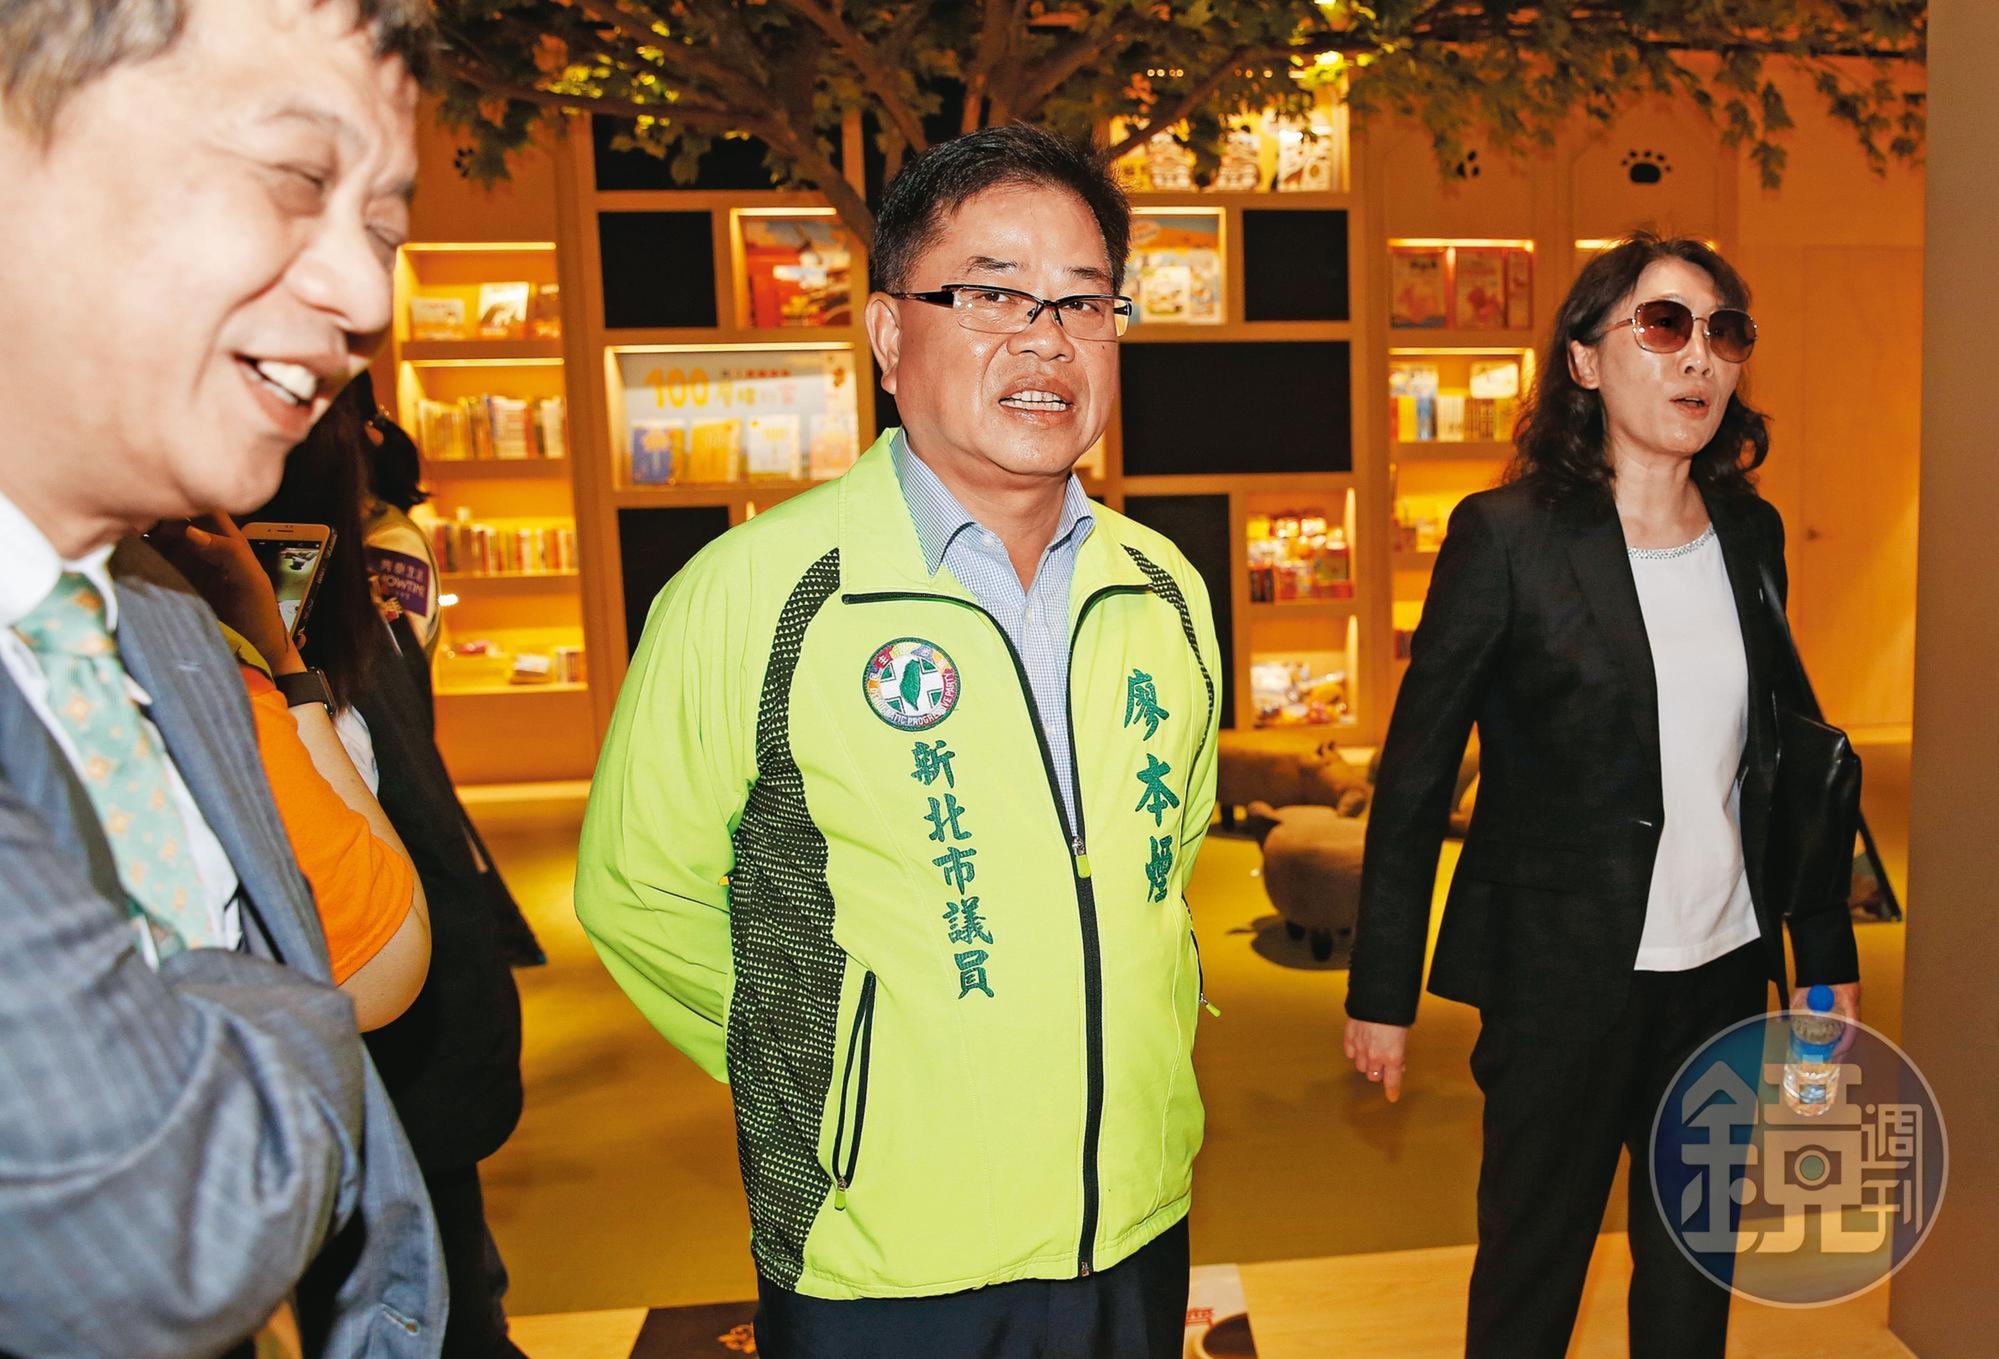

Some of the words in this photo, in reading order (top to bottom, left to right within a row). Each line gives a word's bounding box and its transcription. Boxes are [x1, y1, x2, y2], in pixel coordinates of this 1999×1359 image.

[910, 739, 995, 1000] 新北市議員
